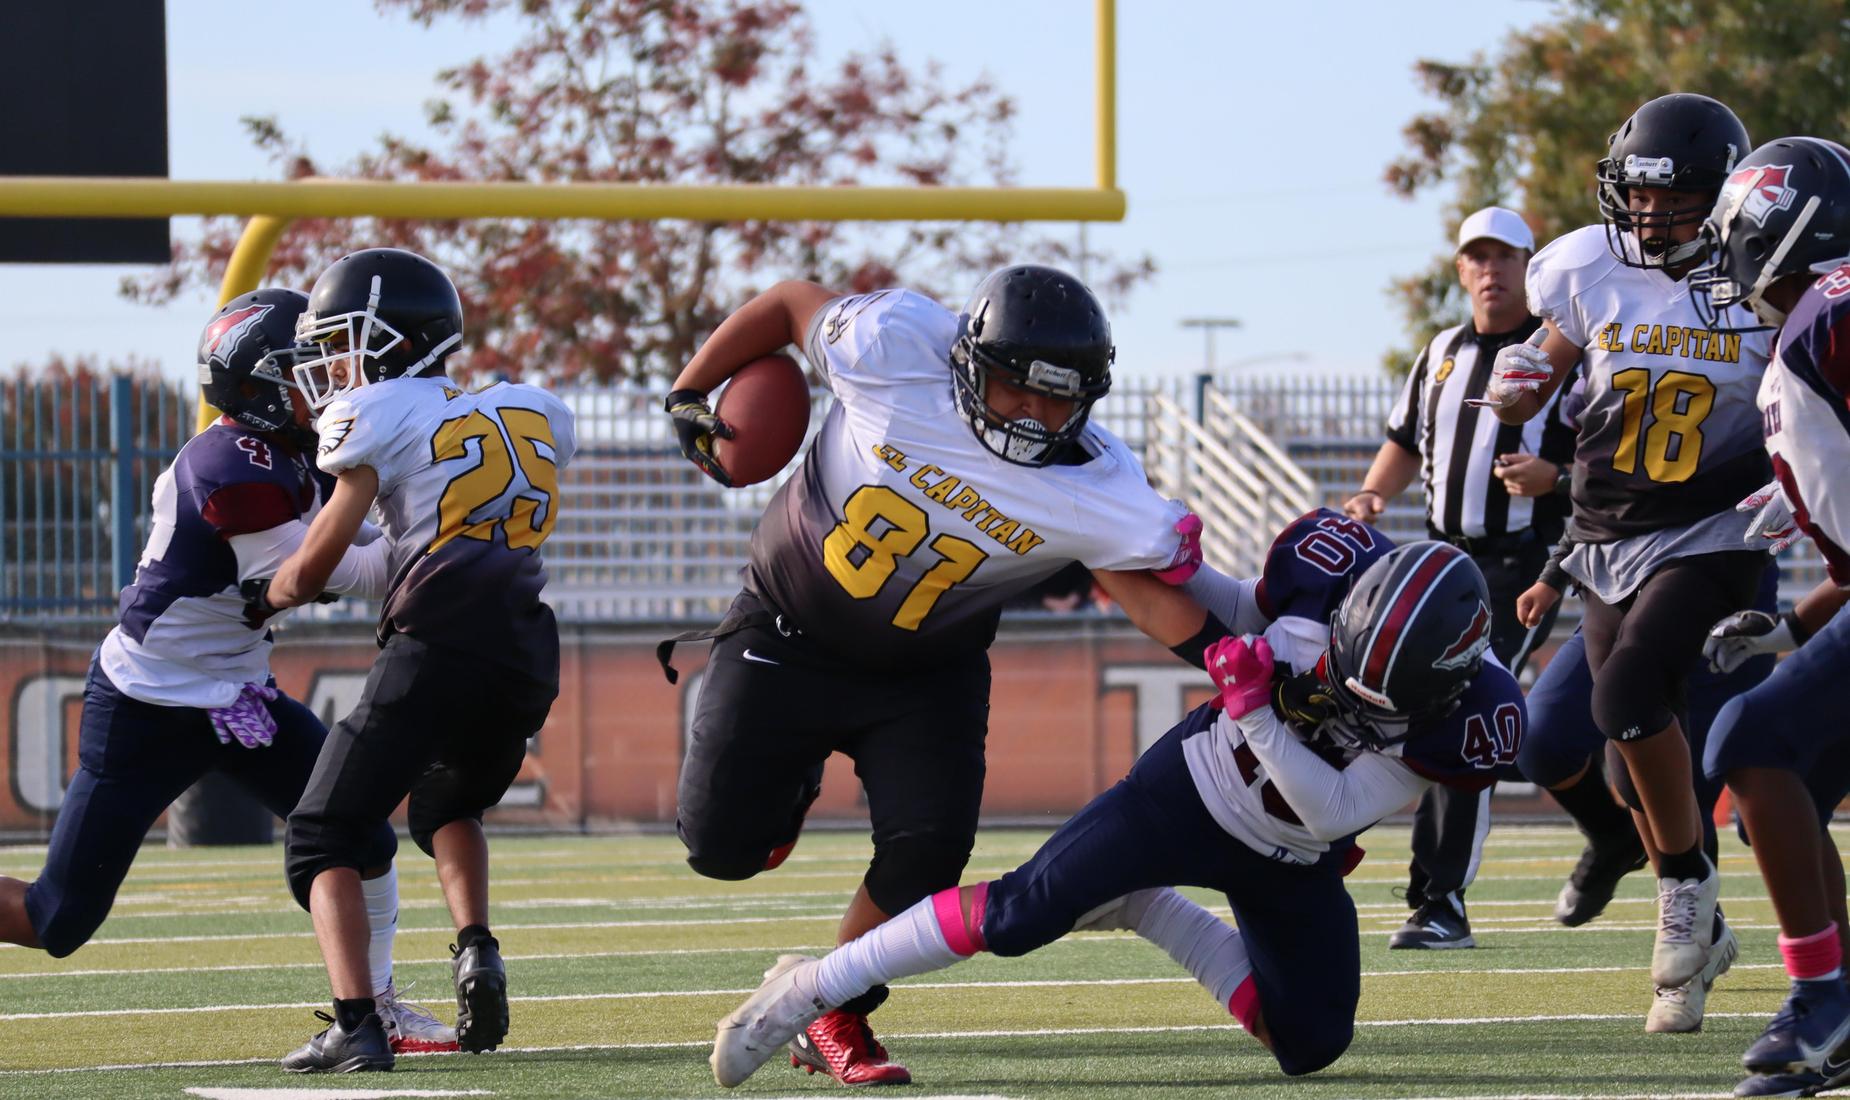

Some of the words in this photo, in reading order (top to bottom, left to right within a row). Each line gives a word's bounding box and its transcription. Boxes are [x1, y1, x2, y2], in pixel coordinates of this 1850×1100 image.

[1598, 323, 1624, 352] EL
[1631, 324, 1742, 363] CAPITAN
[235, 435, 272, 470] 4
[1611, 367, 1717, 483] 18
[428, 407, 562, 555] 25
[872, 444, 907, 472] EL
[909, 464, 1045, 556] CAPITAN
[823, 484, 990, 631] 81
[1295, 518, 1376, 576] 40
[1461, 702, 1522, 768] 40
